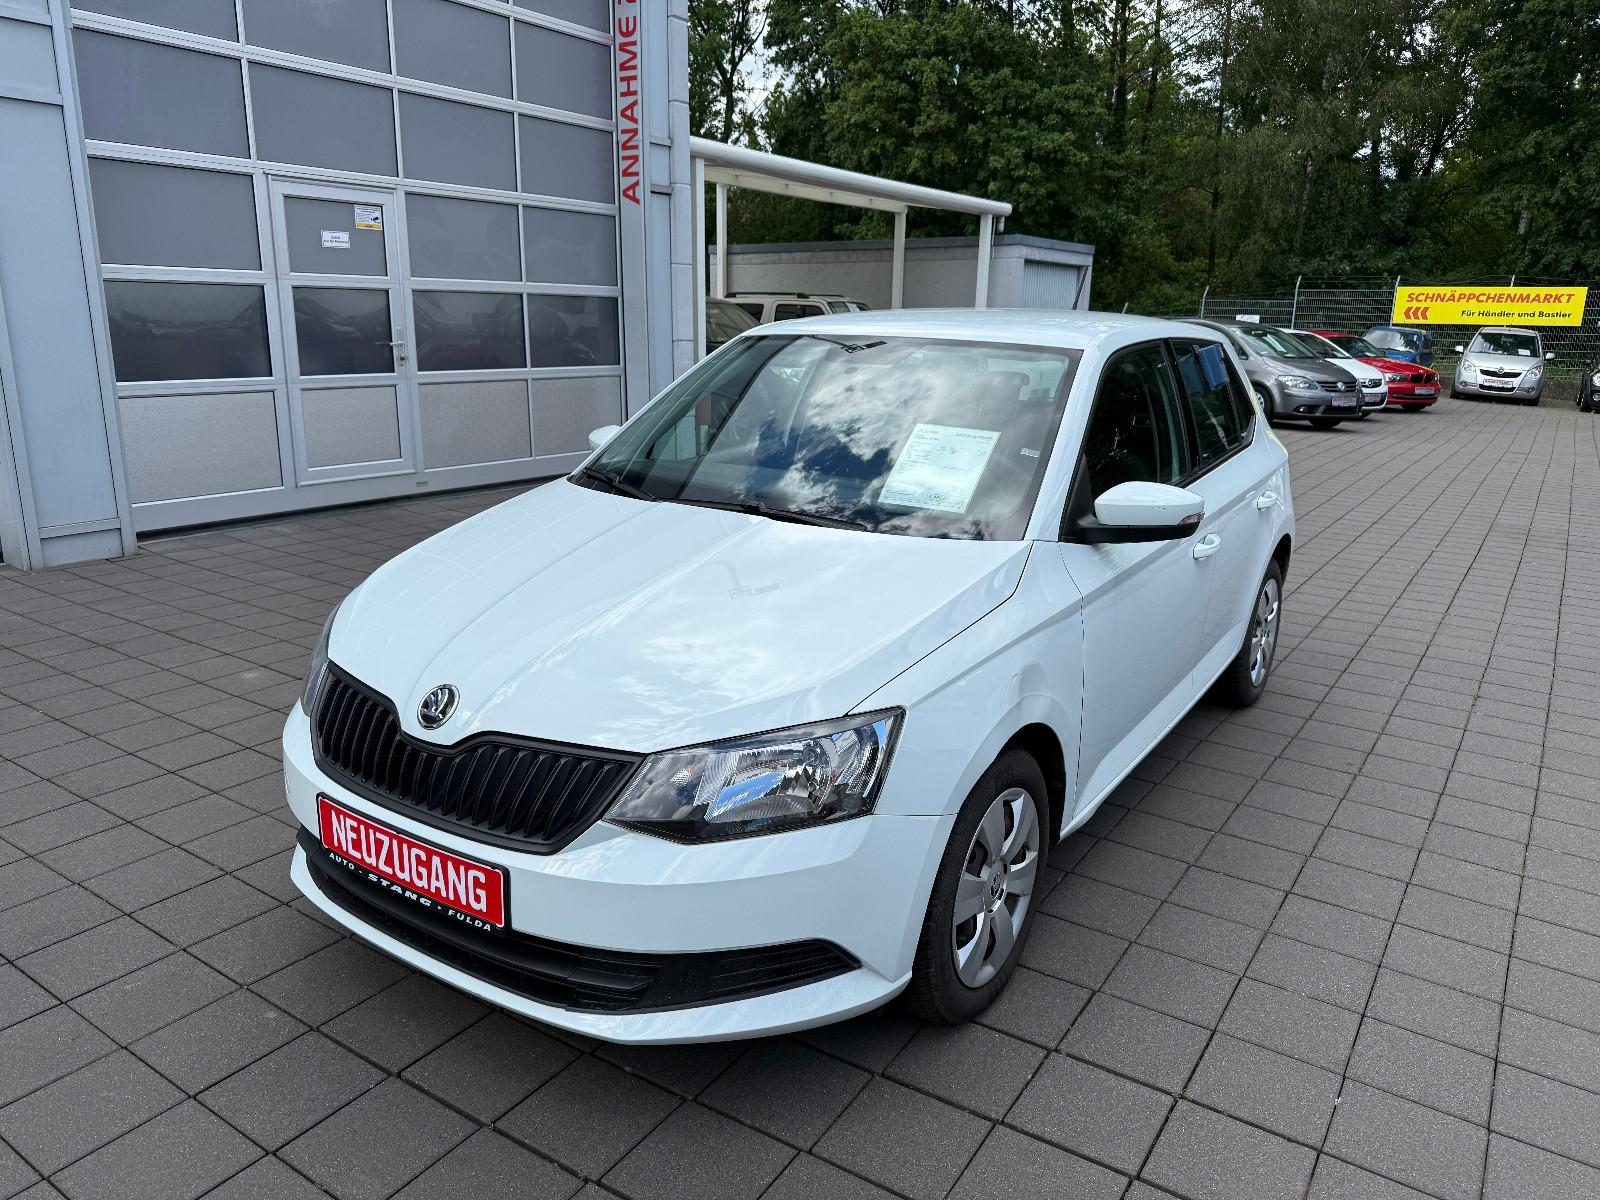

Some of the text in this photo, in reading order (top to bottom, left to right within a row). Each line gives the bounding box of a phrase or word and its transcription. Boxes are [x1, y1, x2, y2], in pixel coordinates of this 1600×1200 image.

[618, 15, 640, 205] ANNAHME
[1406, 290, 1575, 304] SCHNÄPPCHENMARKT
[1478, 310, 1515, 318] Händler
[329, 852, 492, 932] AUTO STANG FULDA
[331, 809, 487, 913] NEUZUGANG
